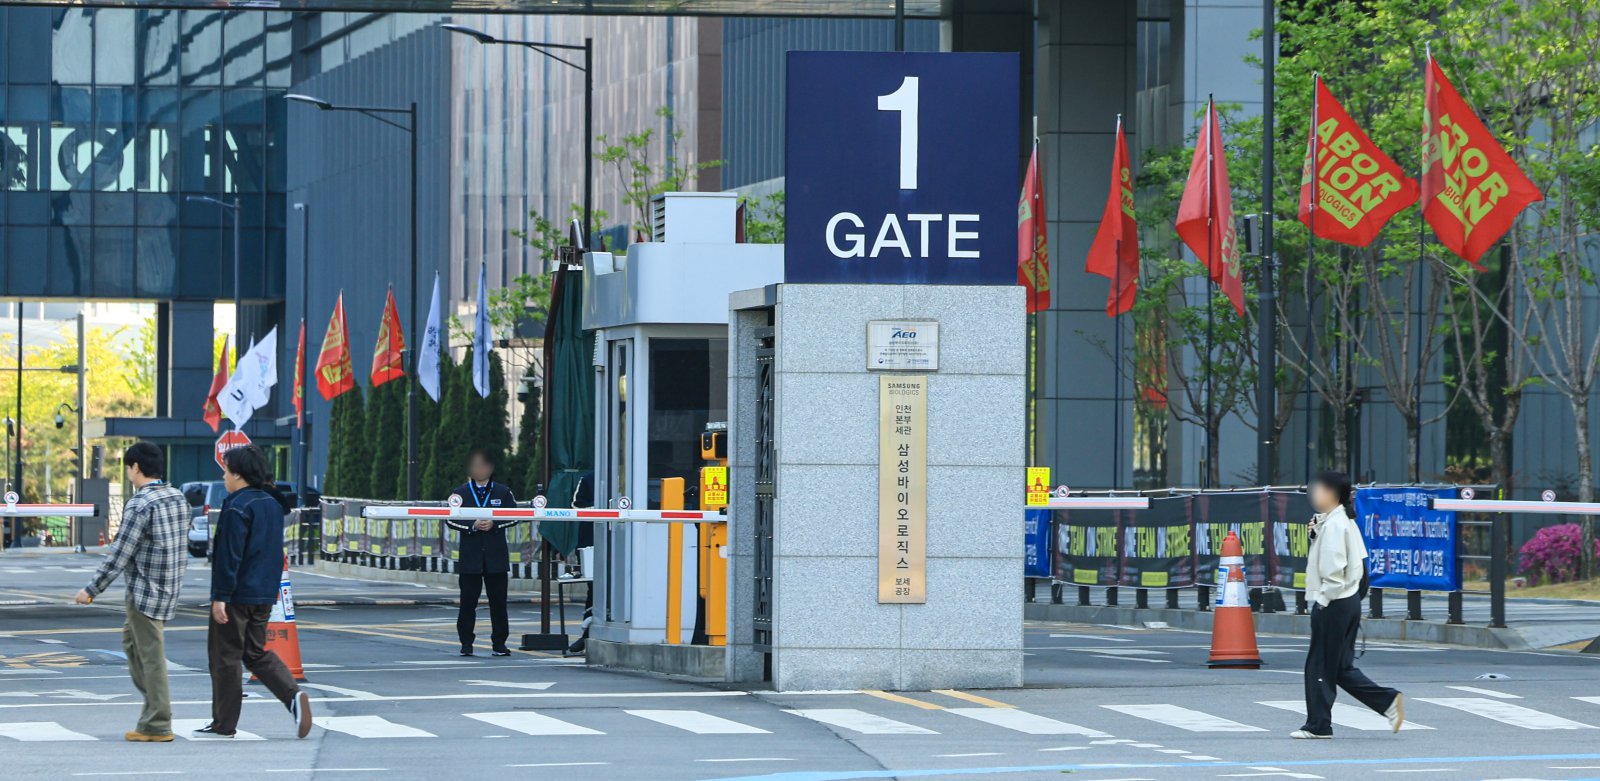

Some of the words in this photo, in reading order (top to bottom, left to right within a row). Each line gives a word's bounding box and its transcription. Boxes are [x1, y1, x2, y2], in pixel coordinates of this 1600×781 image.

[877, 76, 919, 190] 1
[825, 211, 981, 258] GATE
[892, 330, 917, 339] AEO
[895, 404, 912, 414] 인천
[895, 426, 912, 436] 세관
[896, 443, 910, 569] 삼성바이오로직스
[1137, 527, 1156, 558] TEAM
[895, 577, 911, 586] 보세
[895, 587, 911, 596] 공장
